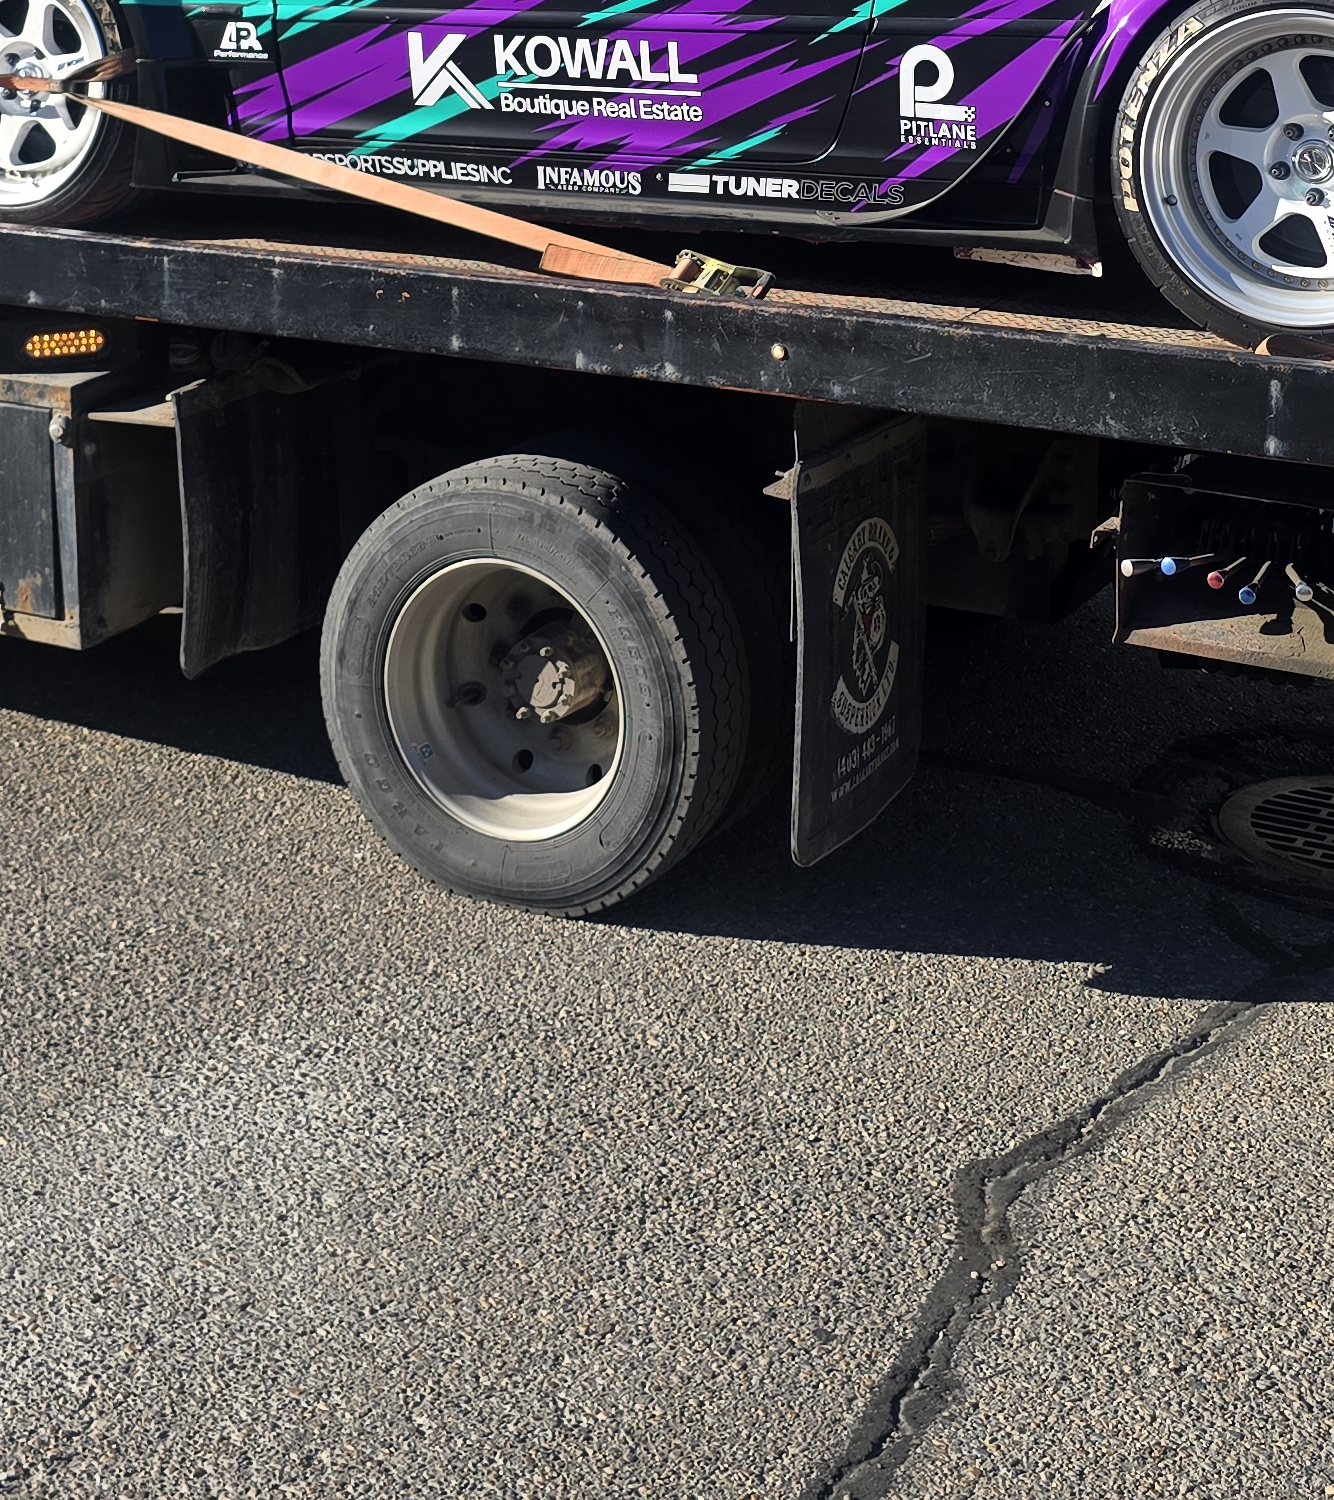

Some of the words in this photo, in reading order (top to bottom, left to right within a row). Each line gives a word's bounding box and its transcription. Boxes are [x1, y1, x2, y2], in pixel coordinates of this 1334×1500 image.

[493, 33, 699, 84] KOWALL
[499, 92, 590, 120] Boutique
[592, 97, 637, 119] Real
[639, 100, 704, 122] Estate
[899, 119, 977, 141] PITLANE
[899, 134, 977, 150] ESSENTIALS
[536, 165, 642, 195] INFAMOUS
[712, 174, 905, 205] TUNERDECALS
